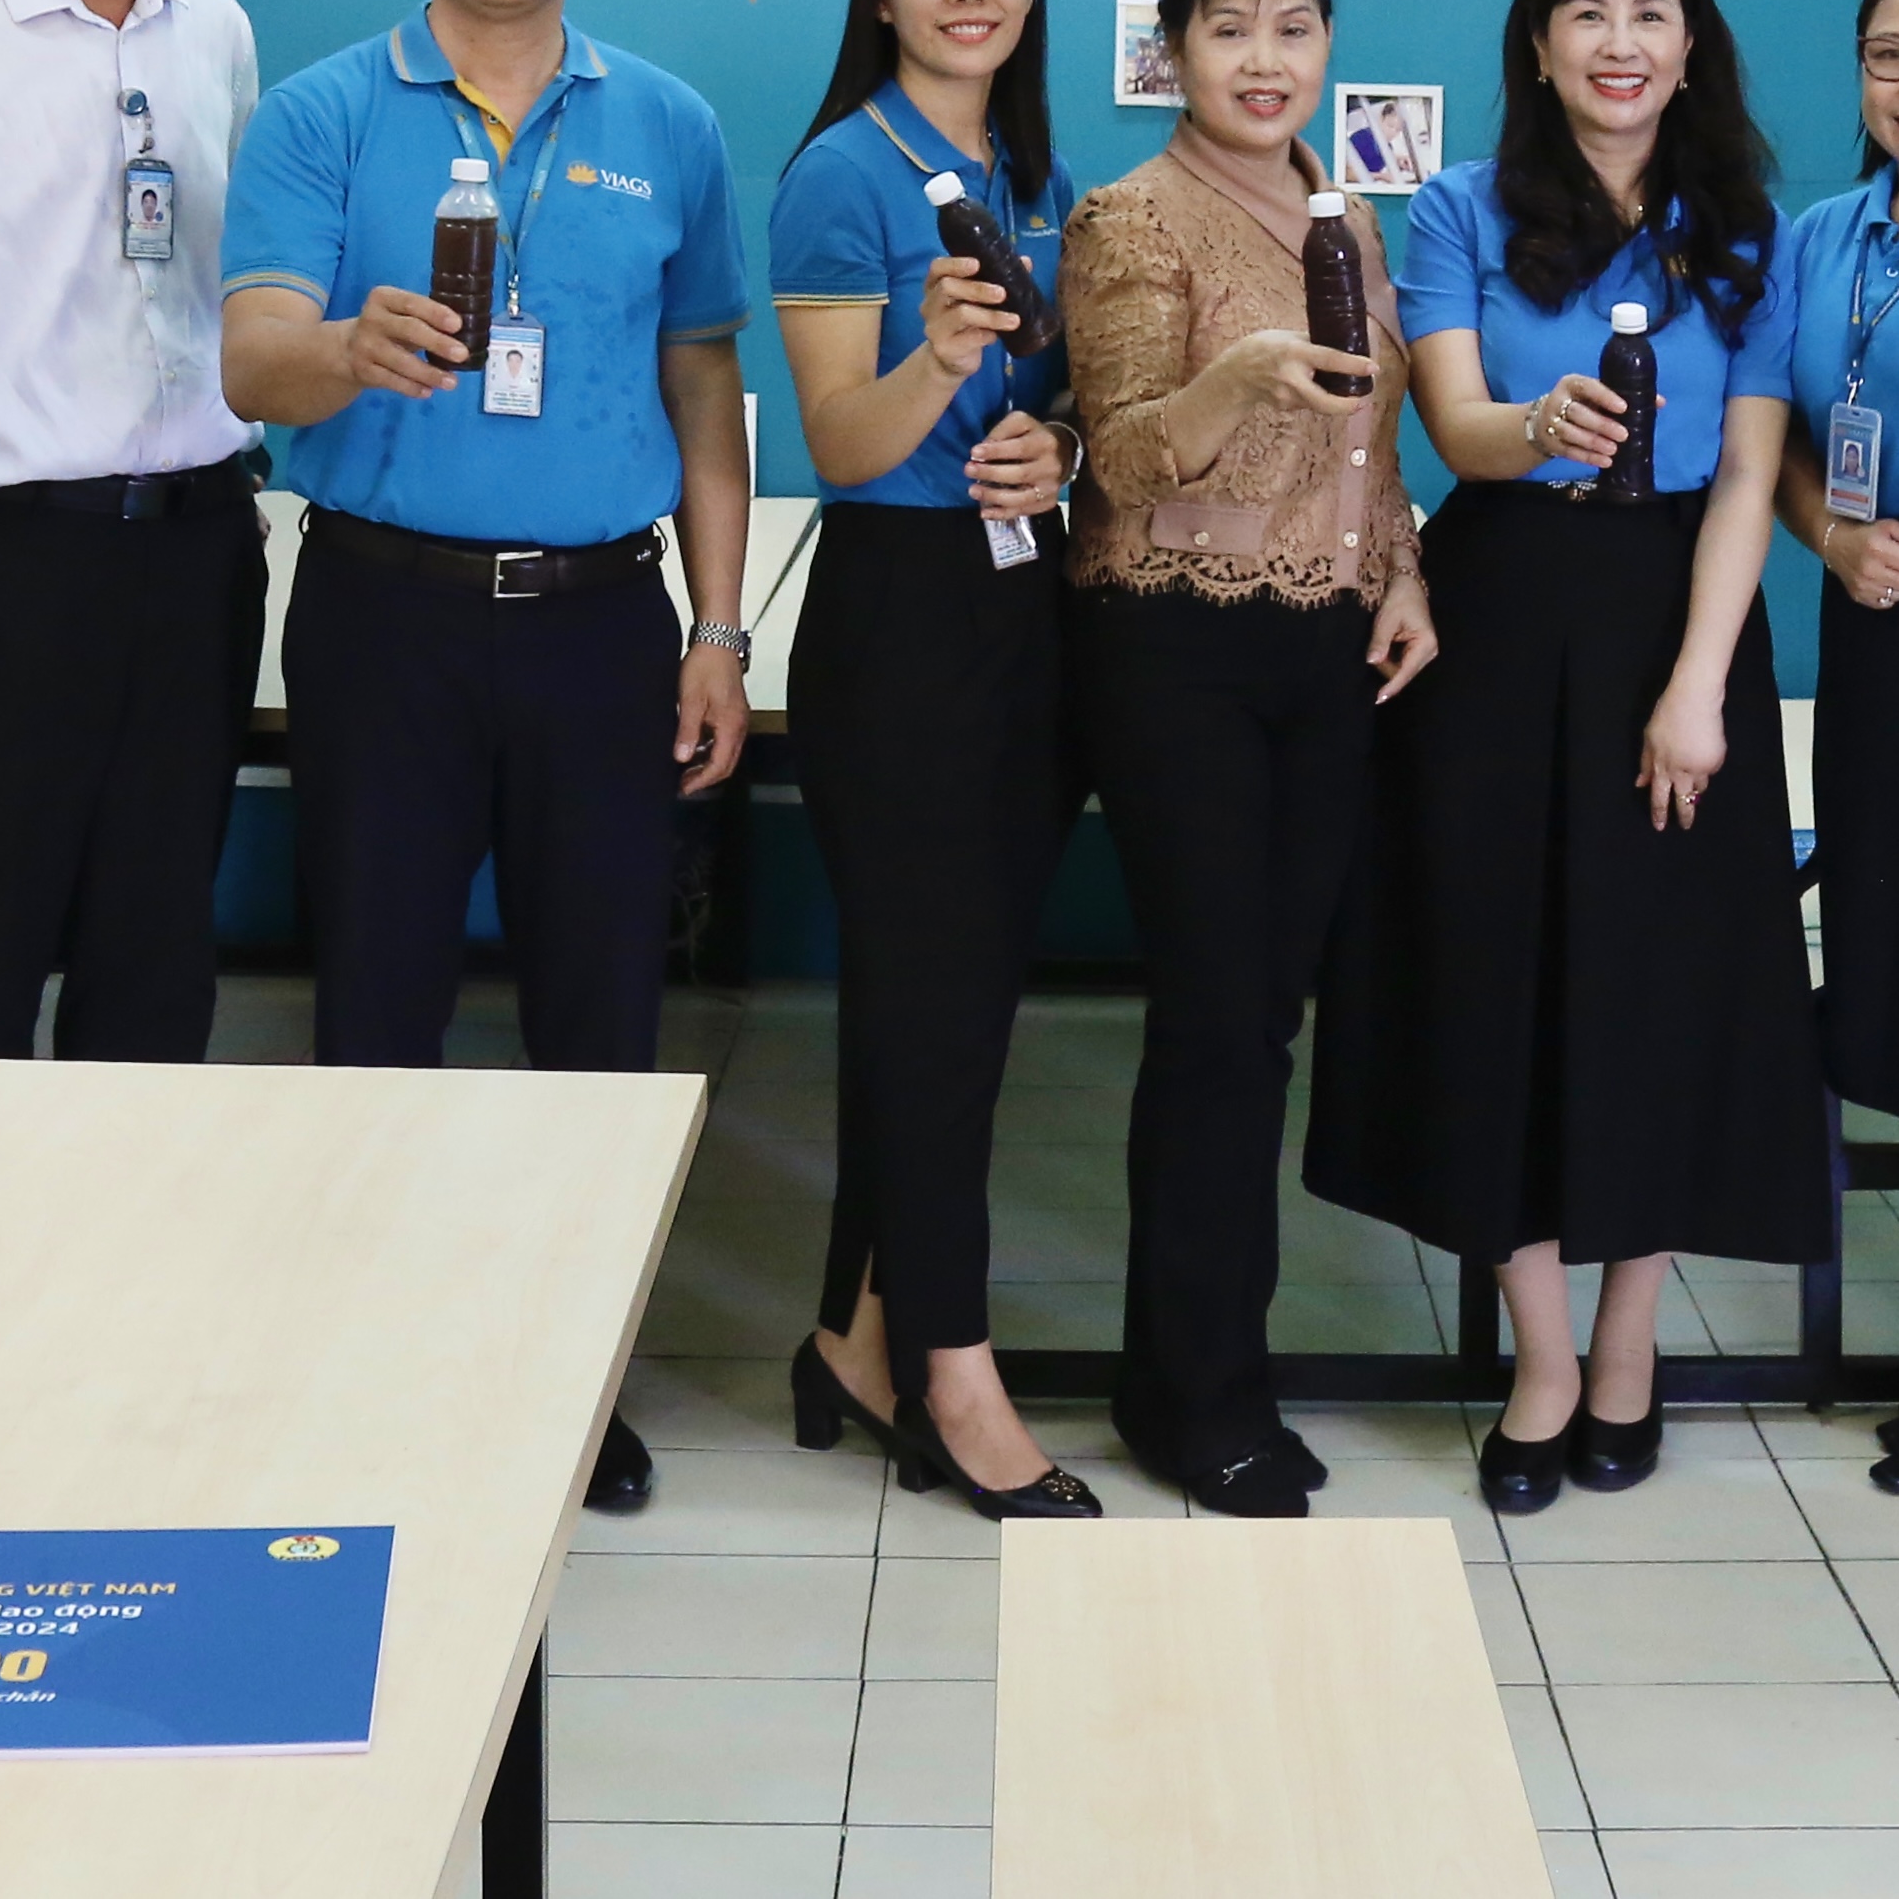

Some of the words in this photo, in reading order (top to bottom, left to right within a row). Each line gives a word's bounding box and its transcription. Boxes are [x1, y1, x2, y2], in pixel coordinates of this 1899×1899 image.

[600, 168, 653, 196] VIAGS
[26, 1581, 96, 1597] VIỆT
[104, 1582, 177, 1595] NAM
[54, 1603, 143, 1620] động
